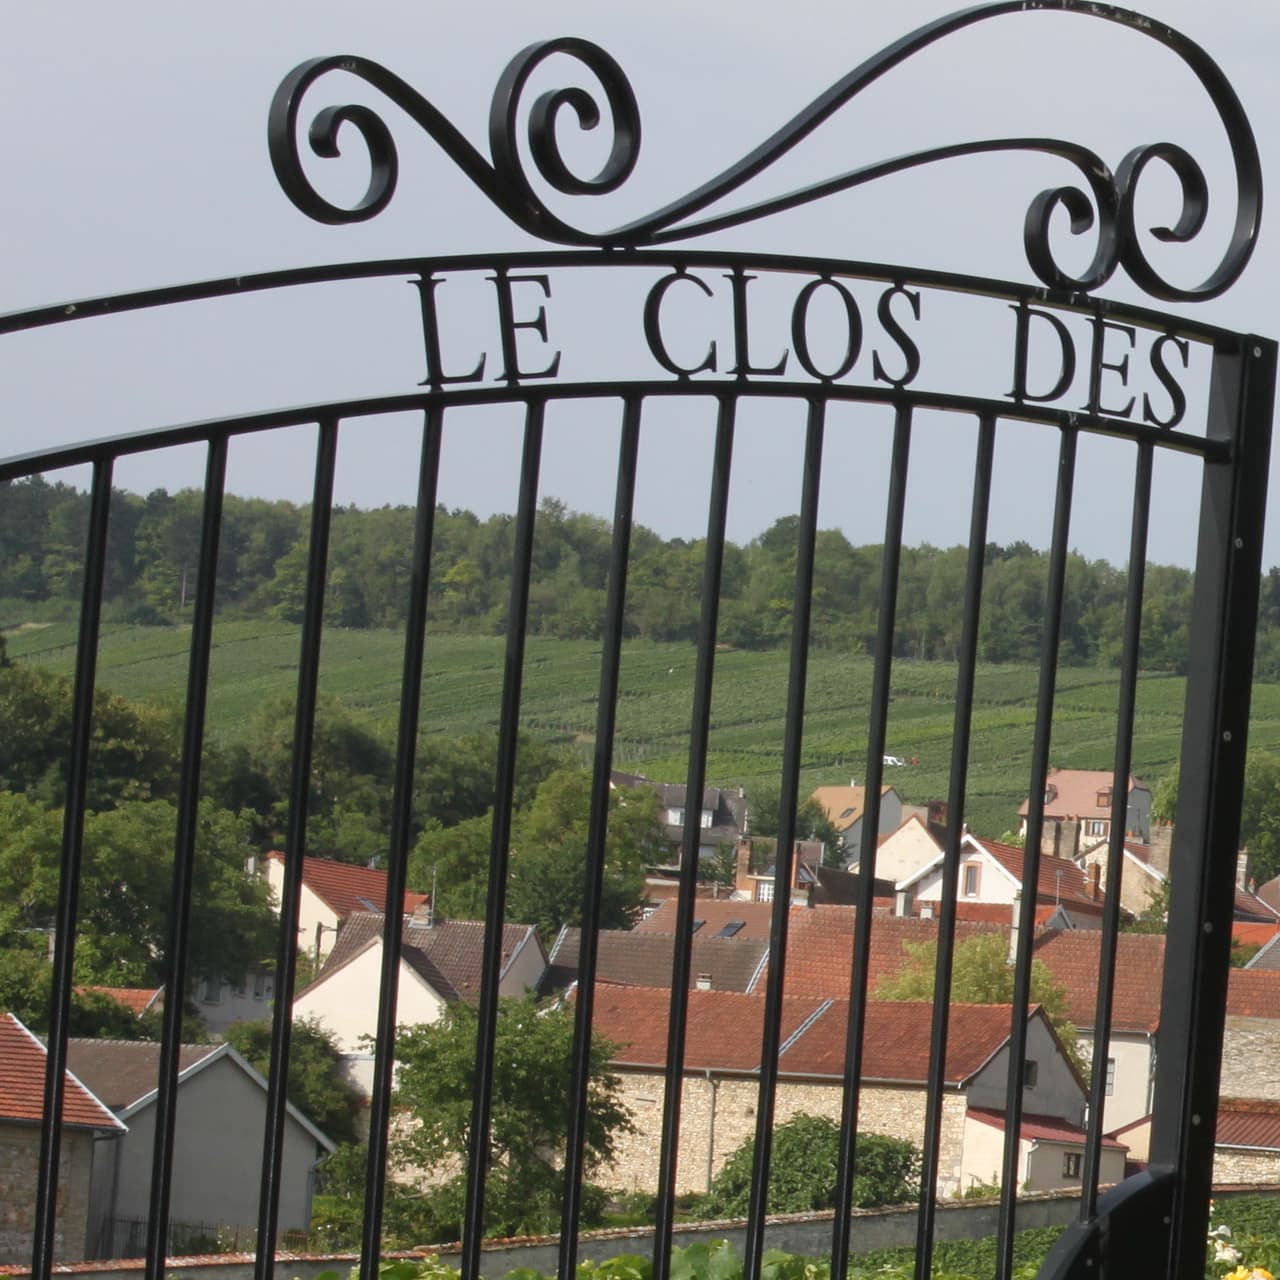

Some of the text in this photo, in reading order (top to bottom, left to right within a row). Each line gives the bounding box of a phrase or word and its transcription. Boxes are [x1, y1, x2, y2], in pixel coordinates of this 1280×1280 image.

[406, 271, 1190, 430] LE CLOS DES
